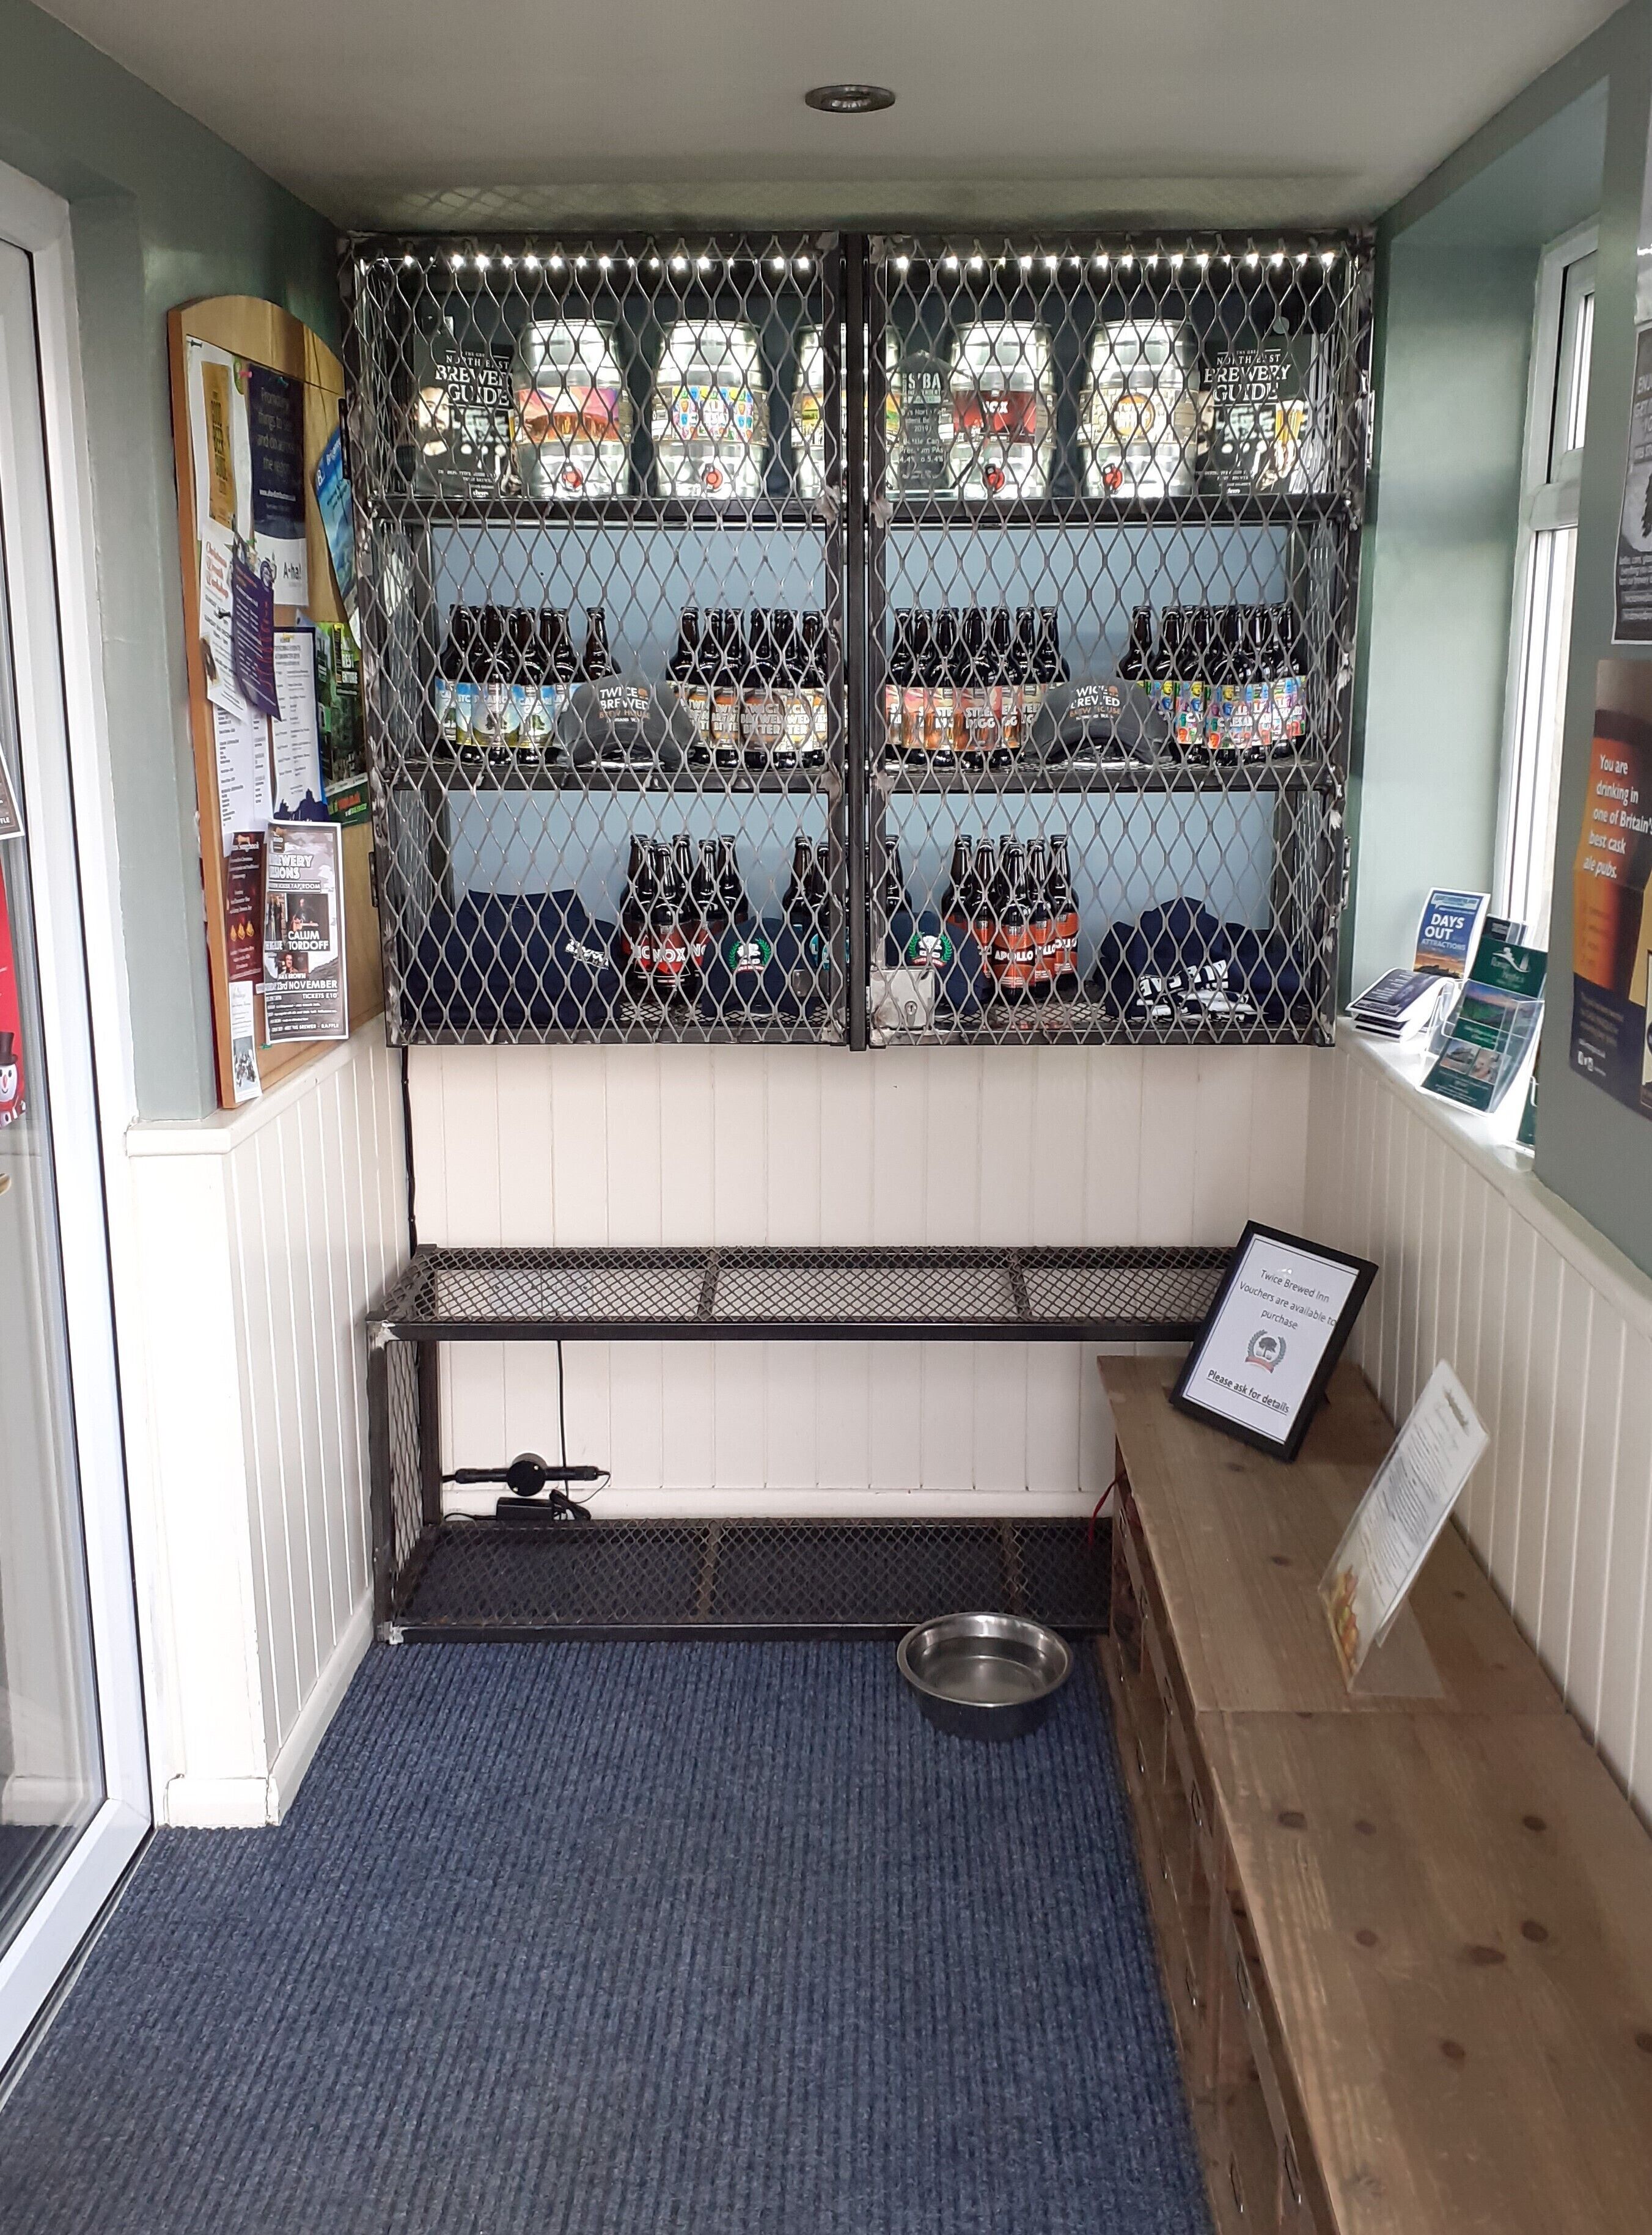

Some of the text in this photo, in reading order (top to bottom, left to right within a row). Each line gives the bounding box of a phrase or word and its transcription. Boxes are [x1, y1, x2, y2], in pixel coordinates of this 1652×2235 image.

[485, 359, 510, 370] EST
[1203, 364, 1292, 383] BREWERY
[448, 383, 510, 406] GUIDE
[1213, 382, 1279, 402] GUIDE
[600, 686, 639, 699] TWICE
[1073, 685, 1108, 697] WICE
[600, 697, 649, 711] BREWED
[743, 724, 780, 734] BITER
[1600, 754, 1628, 775] You are
[1596, 780, 1639, 806] drinking in
[1593, 808, 1608, 822] one
[1609, 810, 1619, 824] of
[1589, 831, 1626, 854] best cask
[269, 854, 313, 868] EWERY
[1583, 857, 1618, 879] ale pubs.
[1431, 913, 1466, 929] DAYS
[287, 930, 320, 941] CALUM
[1424, 925, 1455, 941] OUT
[287, 940, 329, 951] TORDOFF
[1055, 938, 1077, 949] OLLO
[1420, 938, 1466, 951] ATTRACTIONS
[652, 947, 686, 963] NOX
[994, 950, 1034, 961] APLLO
[289, 979, 338, 990] NOVEMBER
[1260, 1269, 1331, 1303] Twice Brewed Inn
[1239, 1281, 1338, 1326] Vouchers are available to
[1261, 1309, 1298, 1330] purchase
[1208, 1369, 1290, 1414] Please ask for details
